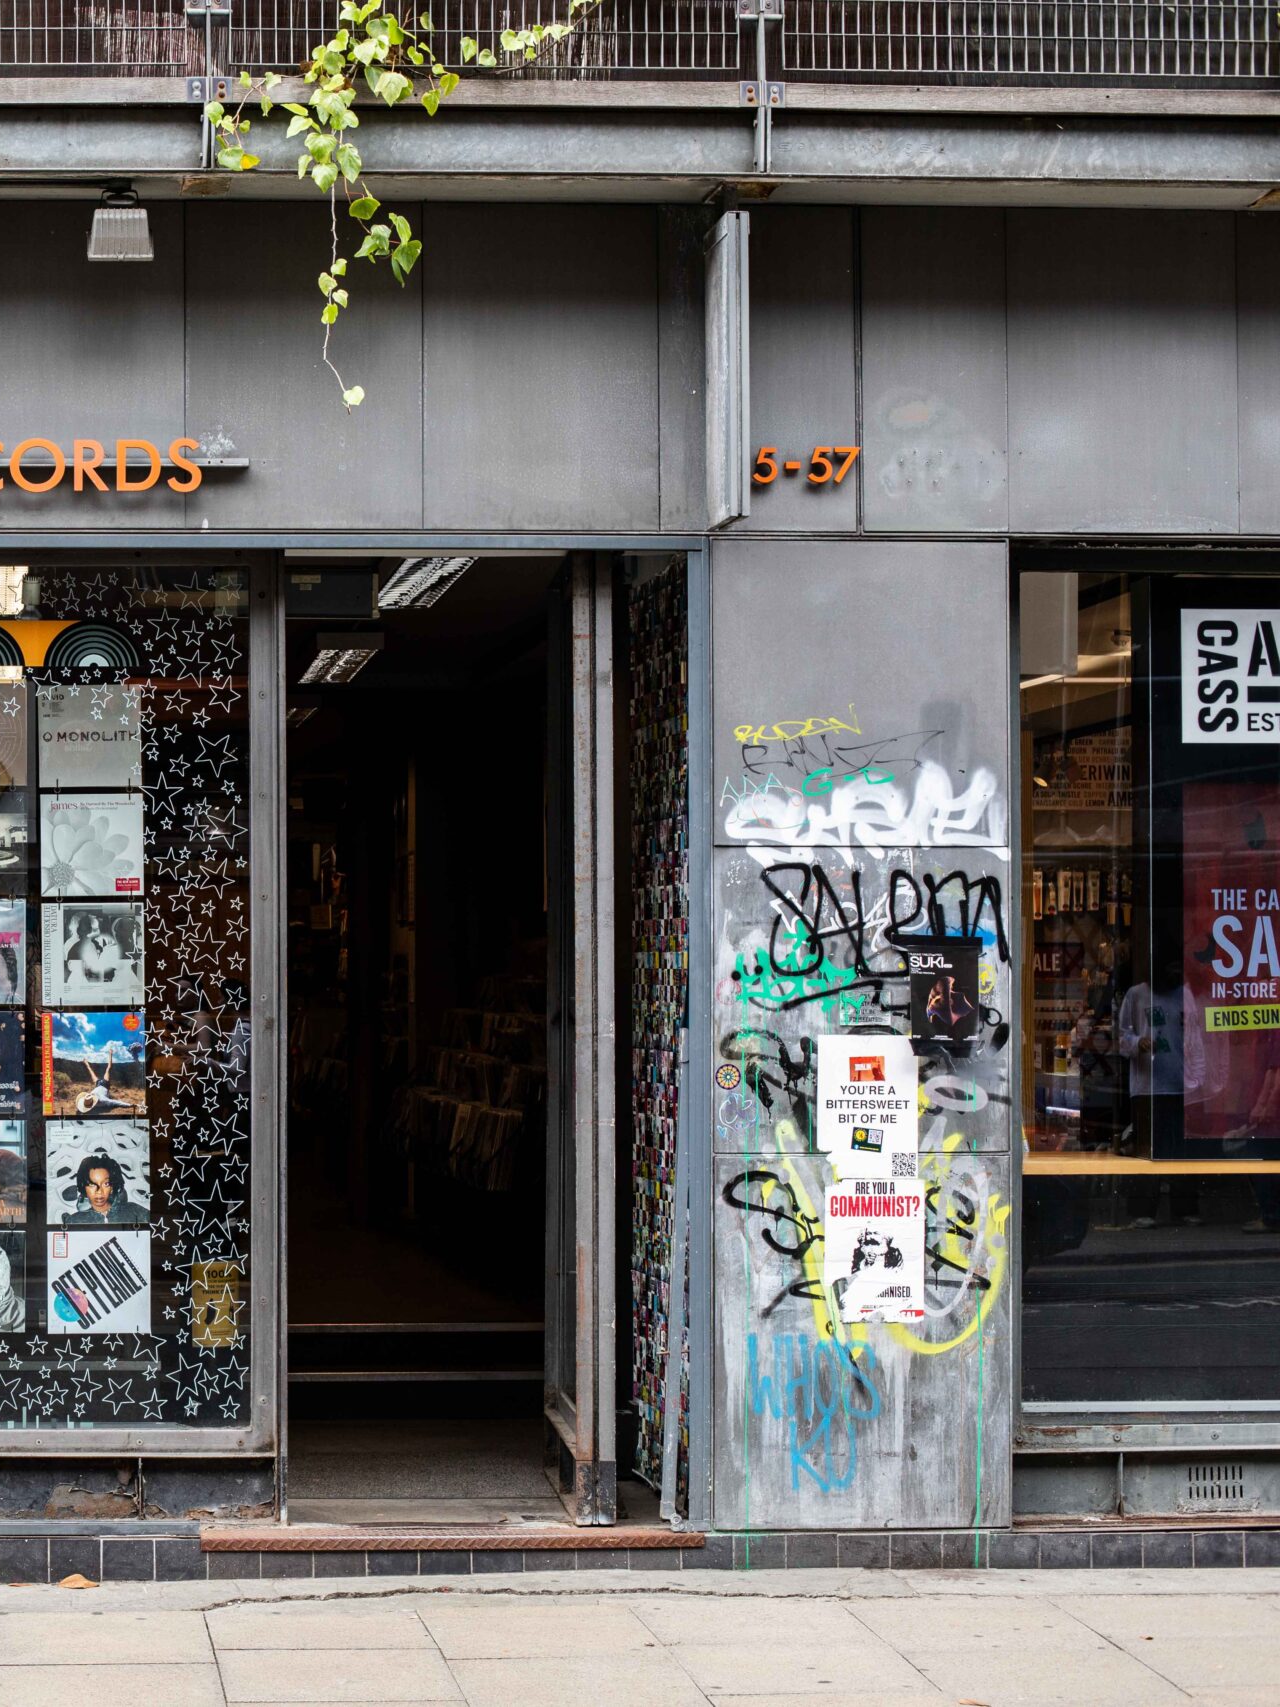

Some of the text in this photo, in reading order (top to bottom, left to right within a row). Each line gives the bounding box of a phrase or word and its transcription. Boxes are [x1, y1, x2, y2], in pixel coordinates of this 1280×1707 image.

[1196, 619, 1239, 732] CASS
[1211, 889, 1248, 911] THE
[910, 956, 945, 969] SUKI
[1211, 982, 1277, 999] IN-STORE
[1213, 1010, 1249, 1027] ENDS
[840, 1085, 896, 1095] YOU'RE A
[826, 1099, 910, 1110] BITTERSWEET
[838, 1113, 897, 1124] BIT OF ME
[855, 1182, 896, 1195] ARE YOU A
[830, 1195, 921, 1218] COMMUNIST?
[73, 1236, 148, 1314] PLANET
